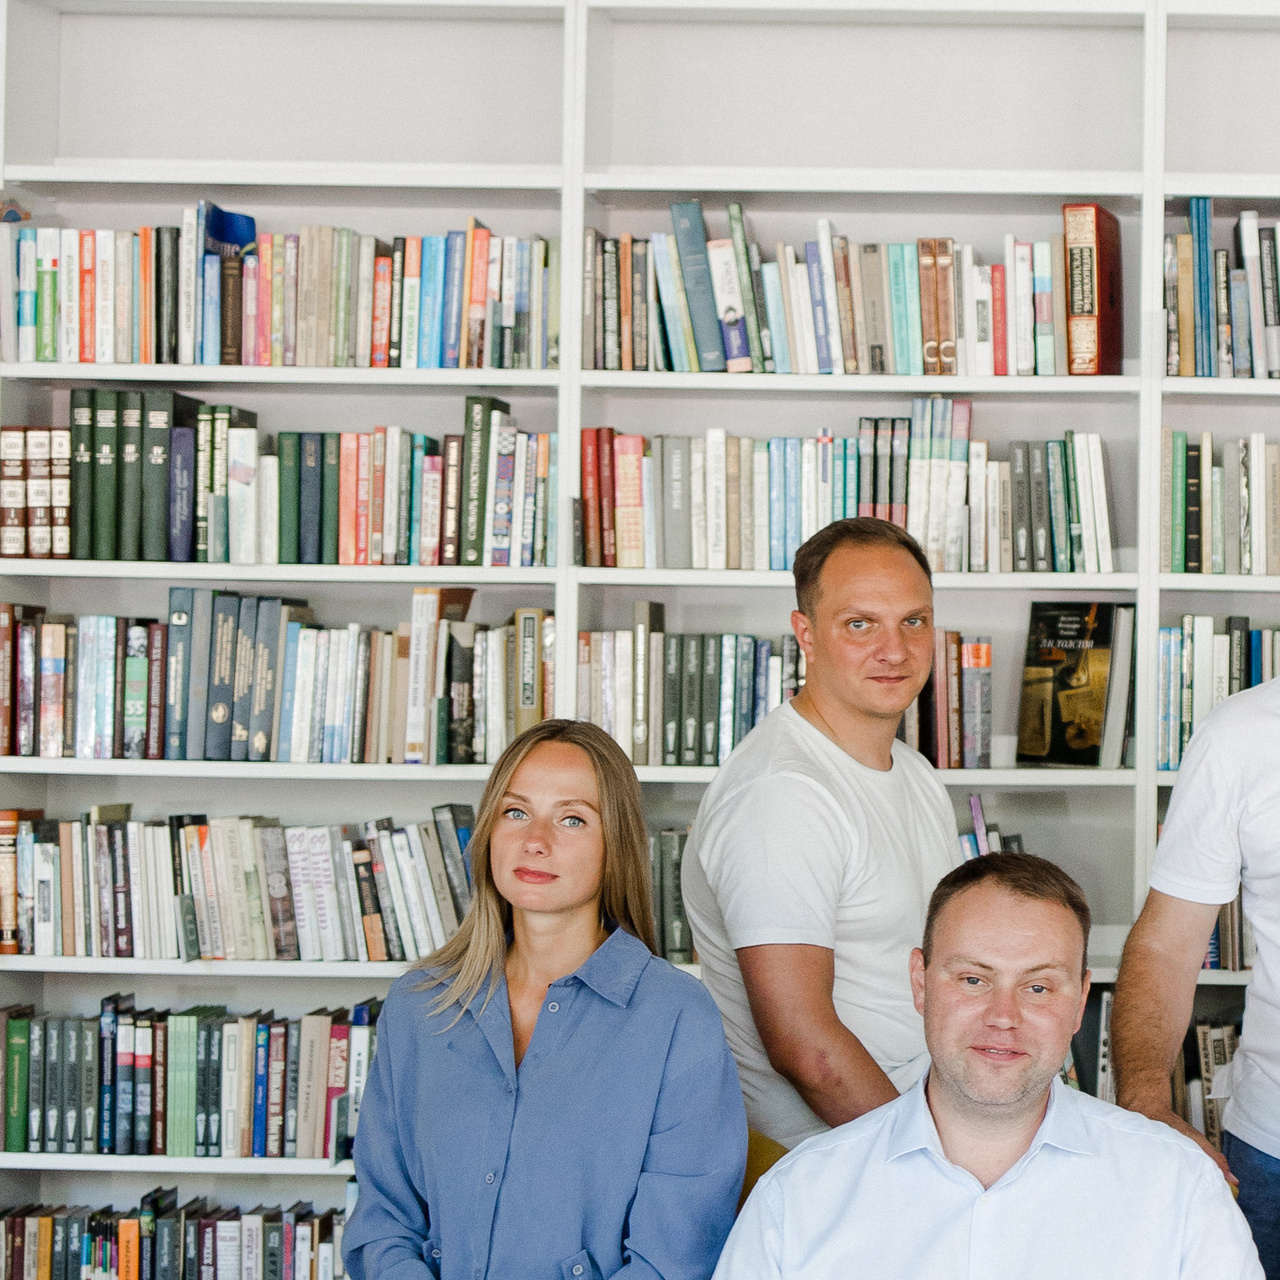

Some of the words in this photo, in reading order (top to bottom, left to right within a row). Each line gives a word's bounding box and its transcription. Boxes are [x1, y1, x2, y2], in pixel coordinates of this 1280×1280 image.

[1072, 248, 1083, 314] ПУШКИНСКАЯ
[1082, 249, 1092, 312] ЭНЦИКЛОПЕДИЯ
[472, 404, 482, 430] СЛОВ
[469, 432, 480, 499] ИНОСТРАННЫХ
[467, 500, 479, 541] СЛОВАРЬ
[523, 638, 534, 685] ЛОТМАН
[1057, 638, 1094, 649] ТОЛСТОЙ
